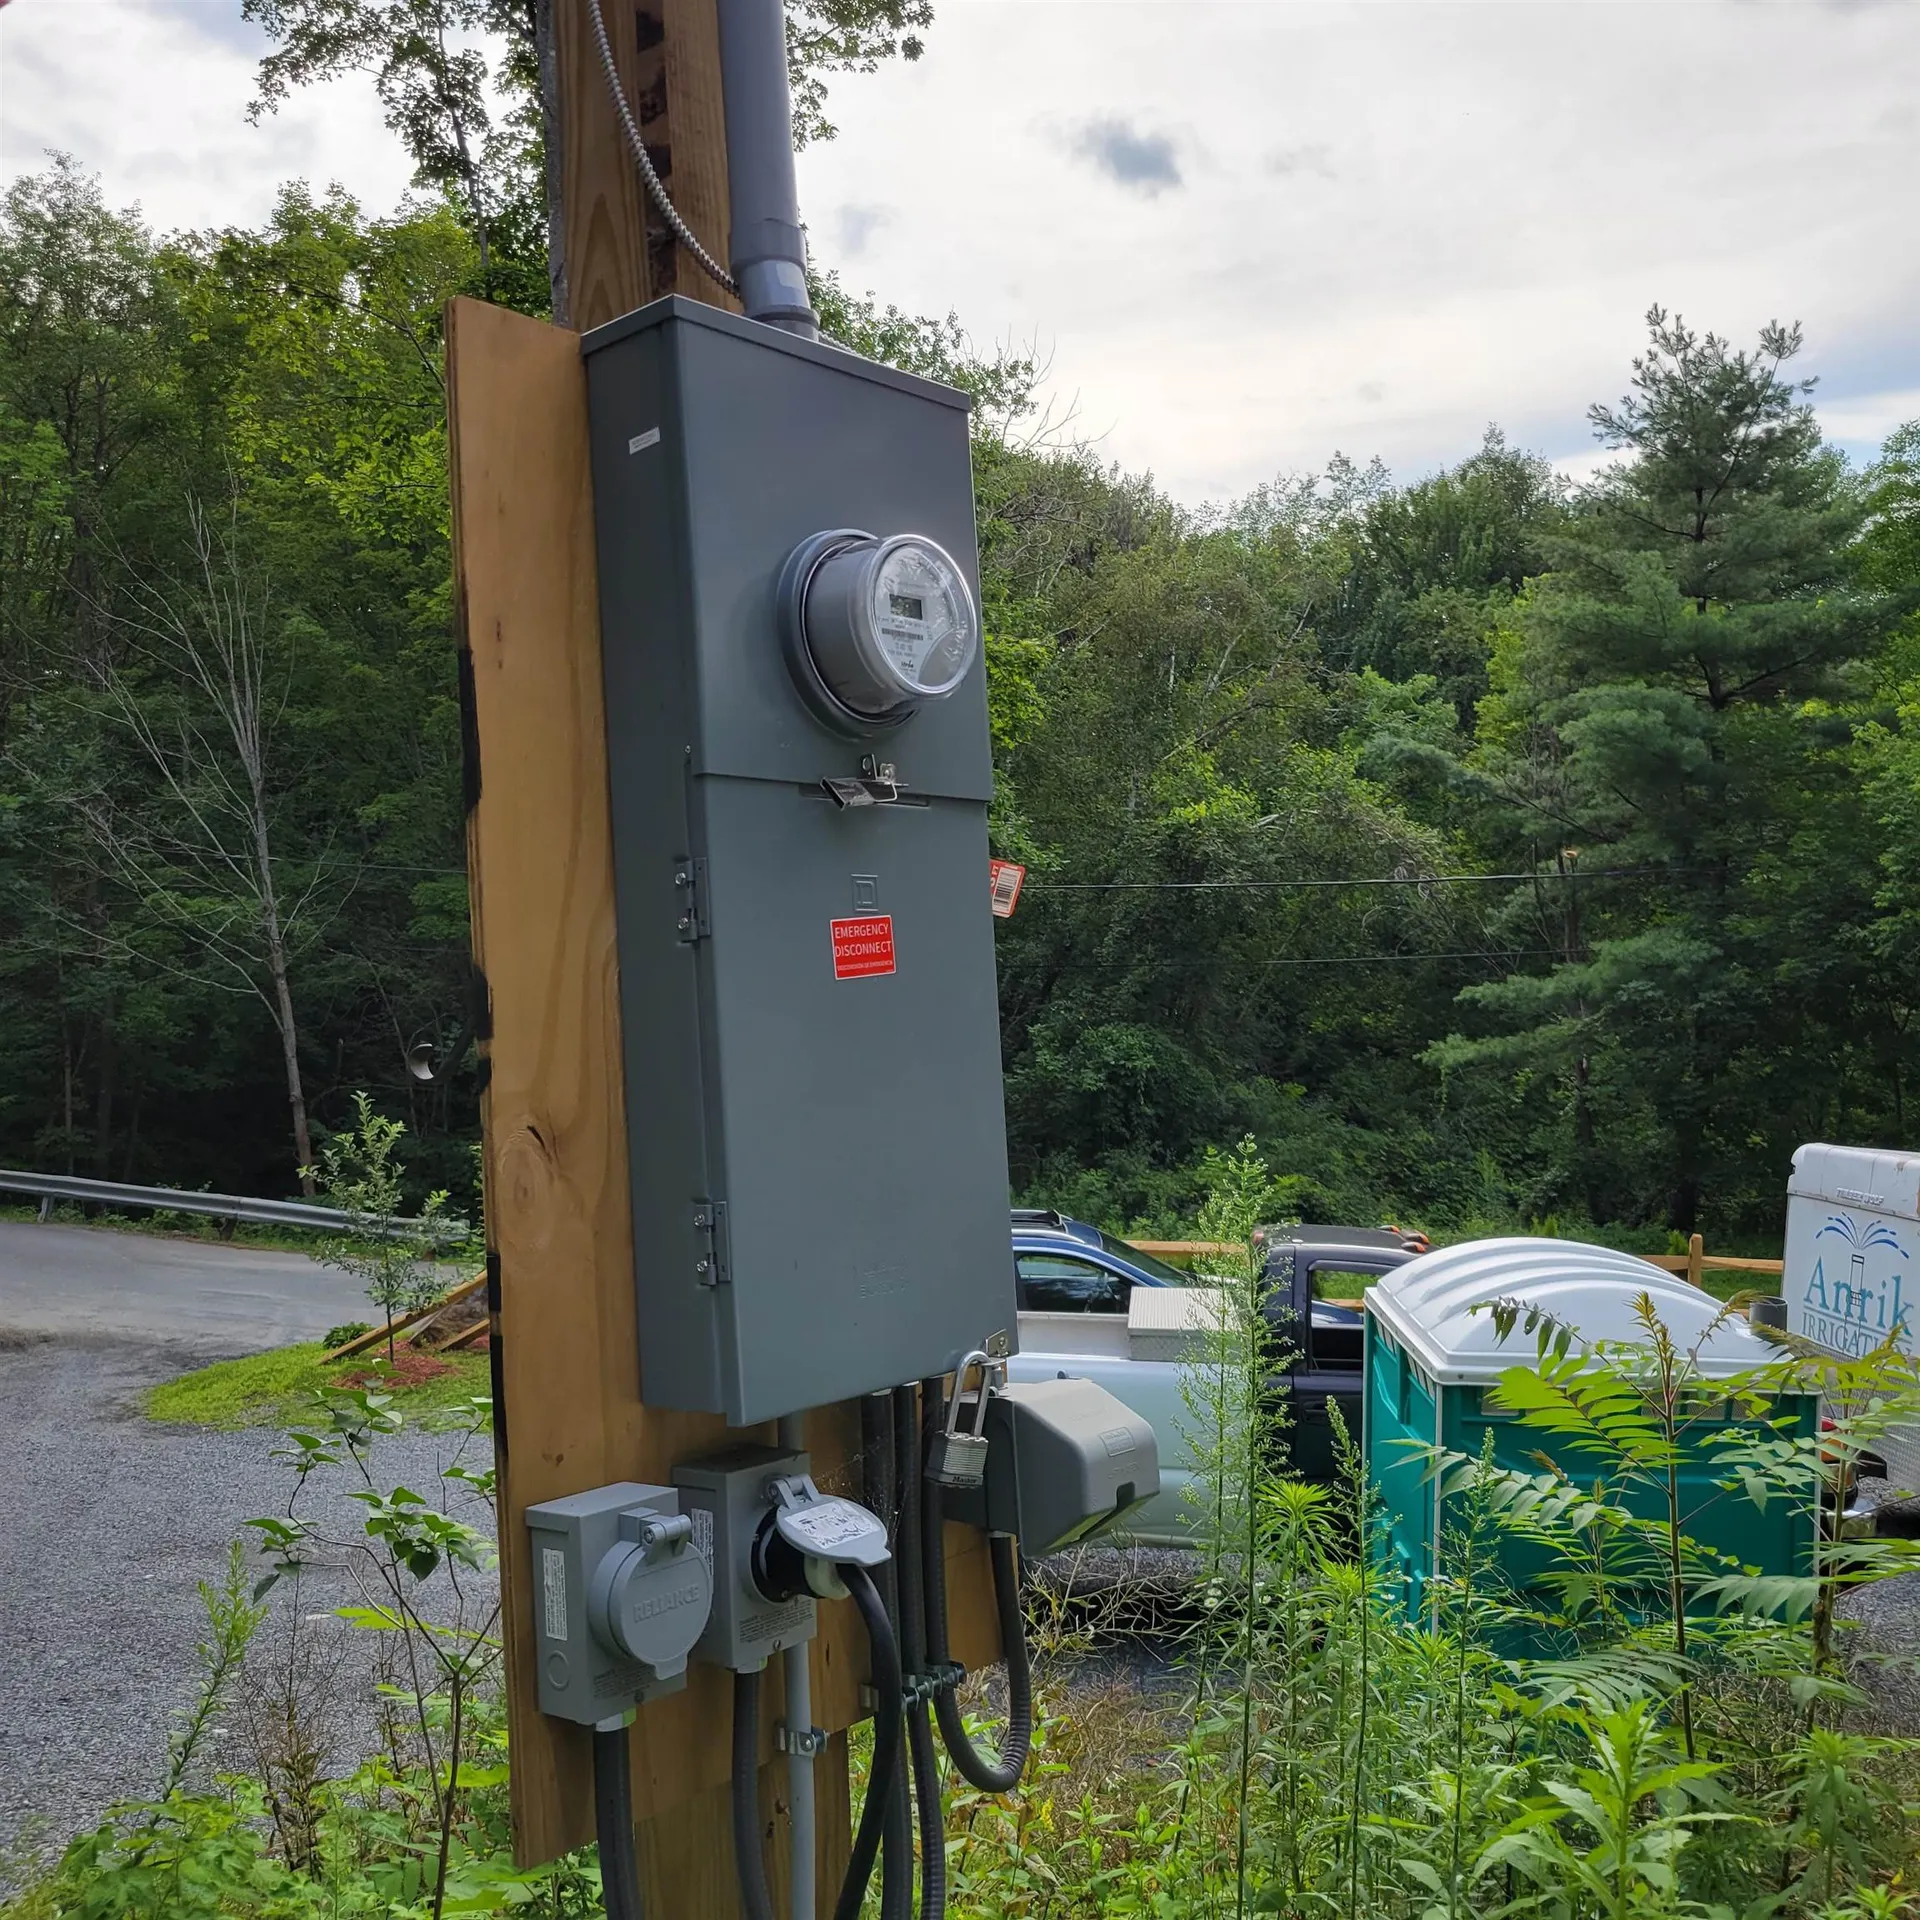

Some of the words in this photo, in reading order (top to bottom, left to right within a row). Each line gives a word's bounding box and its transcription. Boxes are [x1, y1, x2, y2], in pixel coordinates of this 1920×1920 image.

[834, 923, 889, 939] EMERGENCY
[835, 940, 892, 958] DISCONNECT
[1803, 1255, 1914, 1338] Anrik
[1802, 1311, 1913, 1359] IRRIGATI
[633, 1583, 701, 1624] RELIANCE
